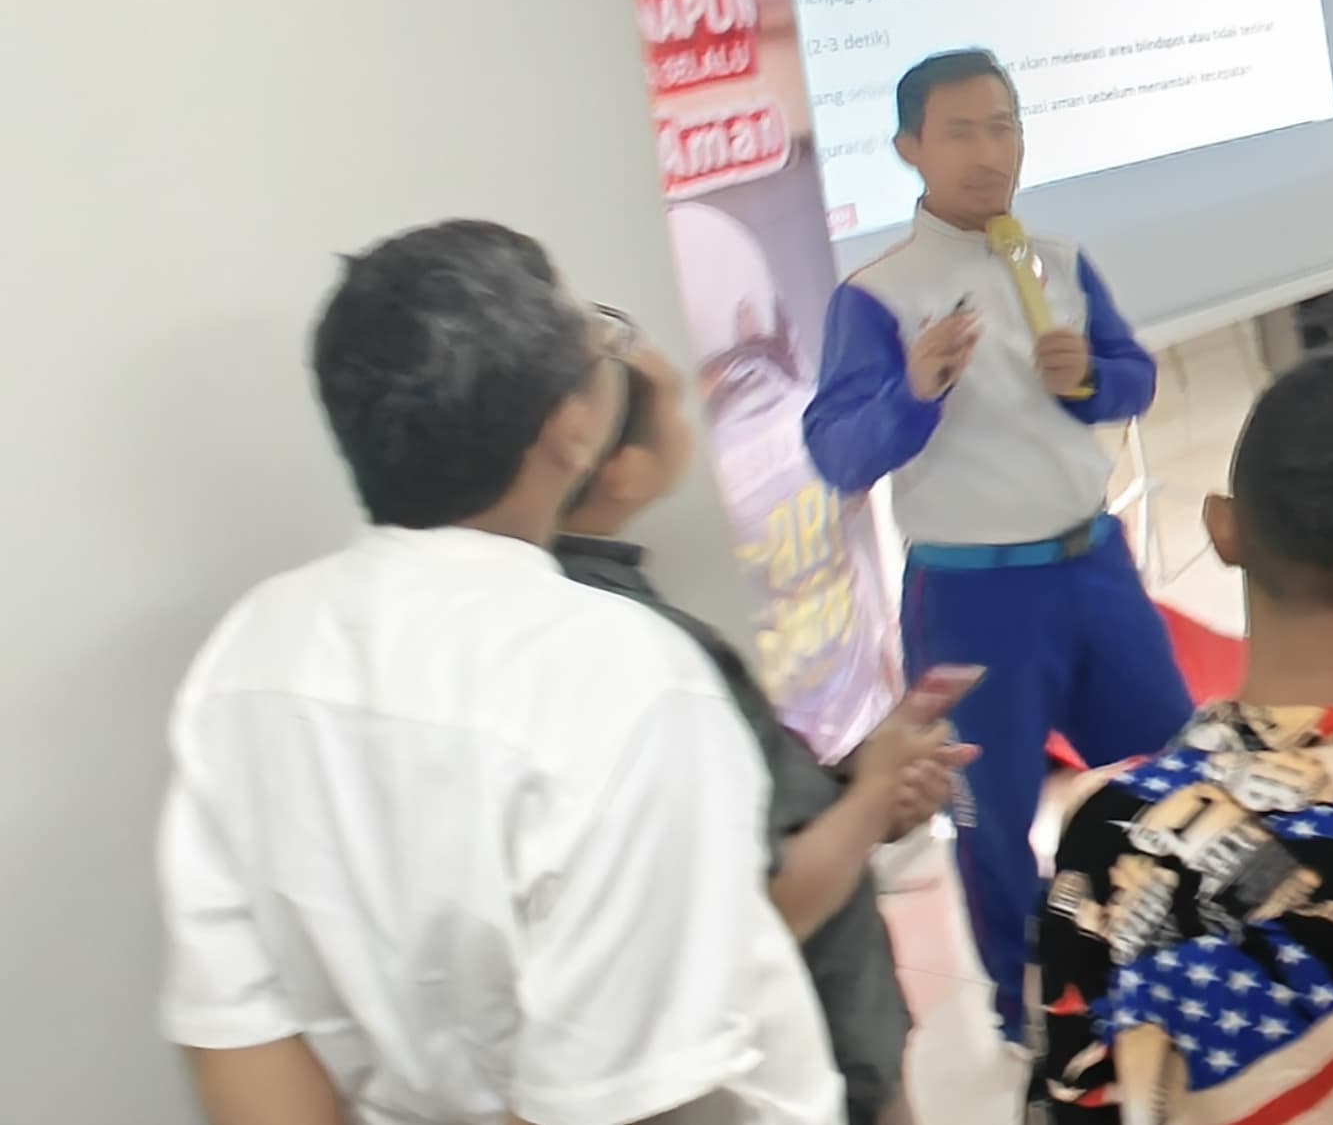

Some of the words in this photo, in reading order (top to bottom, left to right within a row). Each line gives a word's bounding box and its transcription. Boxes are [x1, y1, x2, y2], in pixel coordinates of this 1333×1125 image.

[806, 38, 840, 58] (2-3
[844, 29, 891, 52] detik)
[1019, 56, 1049, 72] akan
[1109, 44, 1133, 58] area
[1188, 32, 1211, 45] atau
[1051, 95, 1085, 111] aman
[1088, 84, 1136, 104] sebelum
